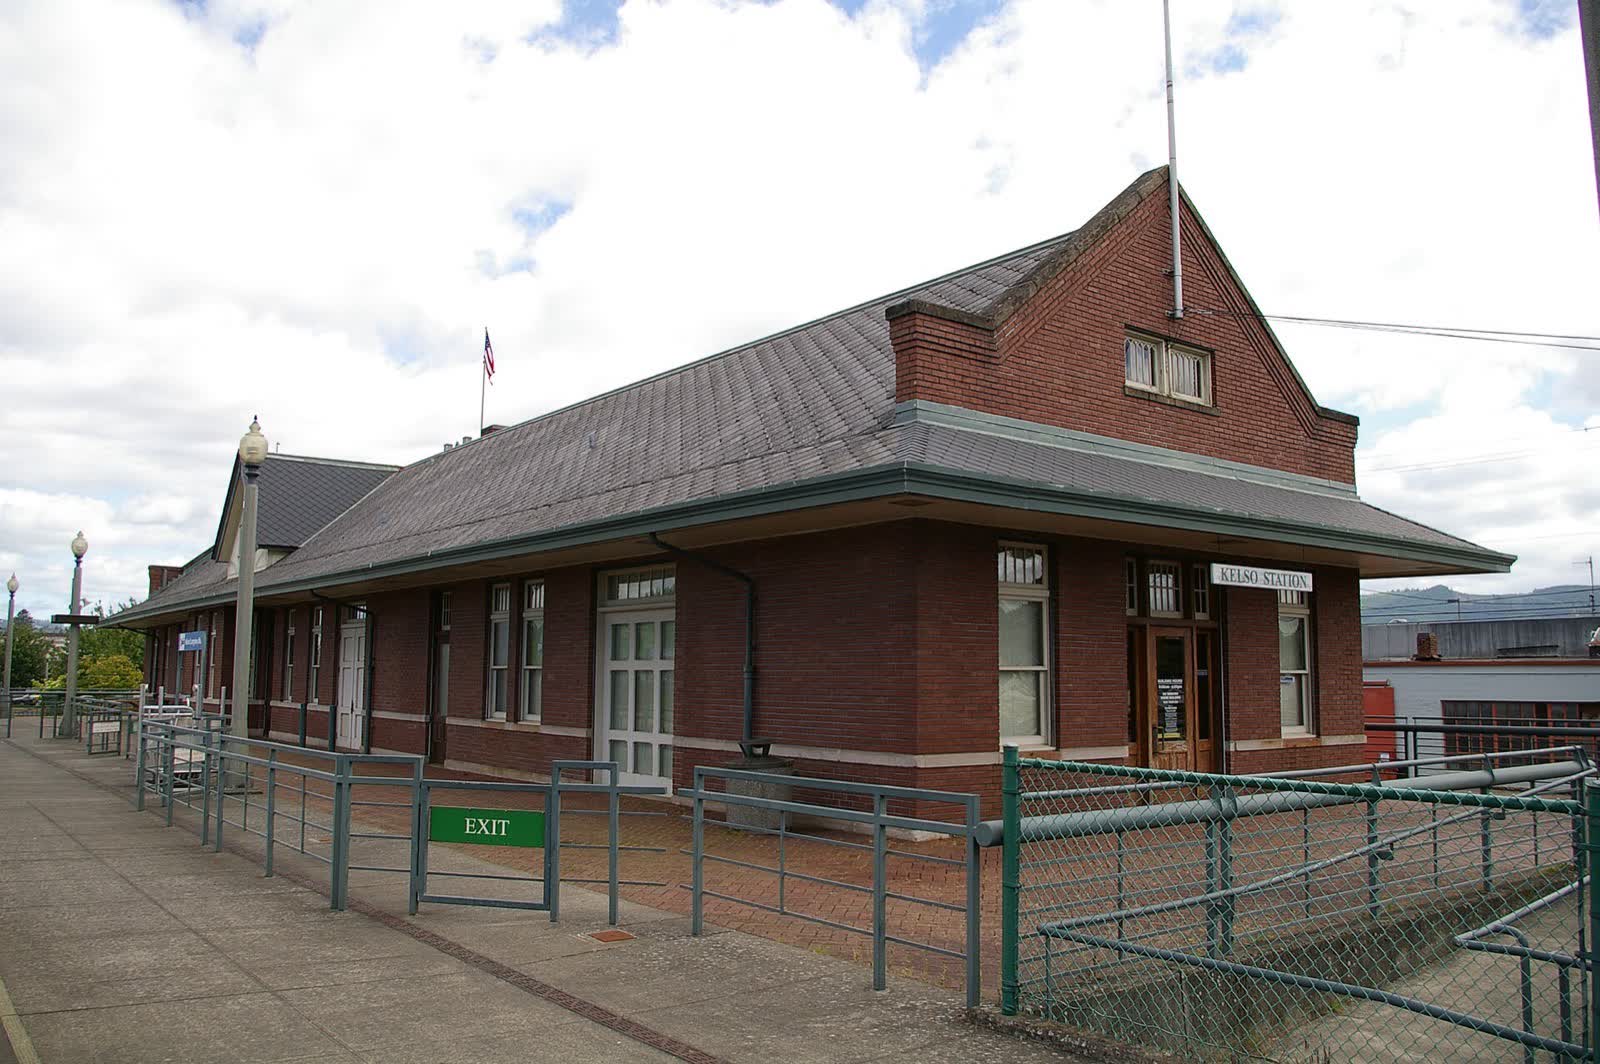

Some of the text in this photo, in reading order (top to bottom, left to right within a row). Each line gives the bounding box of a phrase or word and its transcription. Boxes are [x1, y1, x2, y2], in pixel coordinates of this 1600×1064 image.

[1221, 567, 1307, 589] KELSO STATION
[464, 817, 510, 836] EXIT
